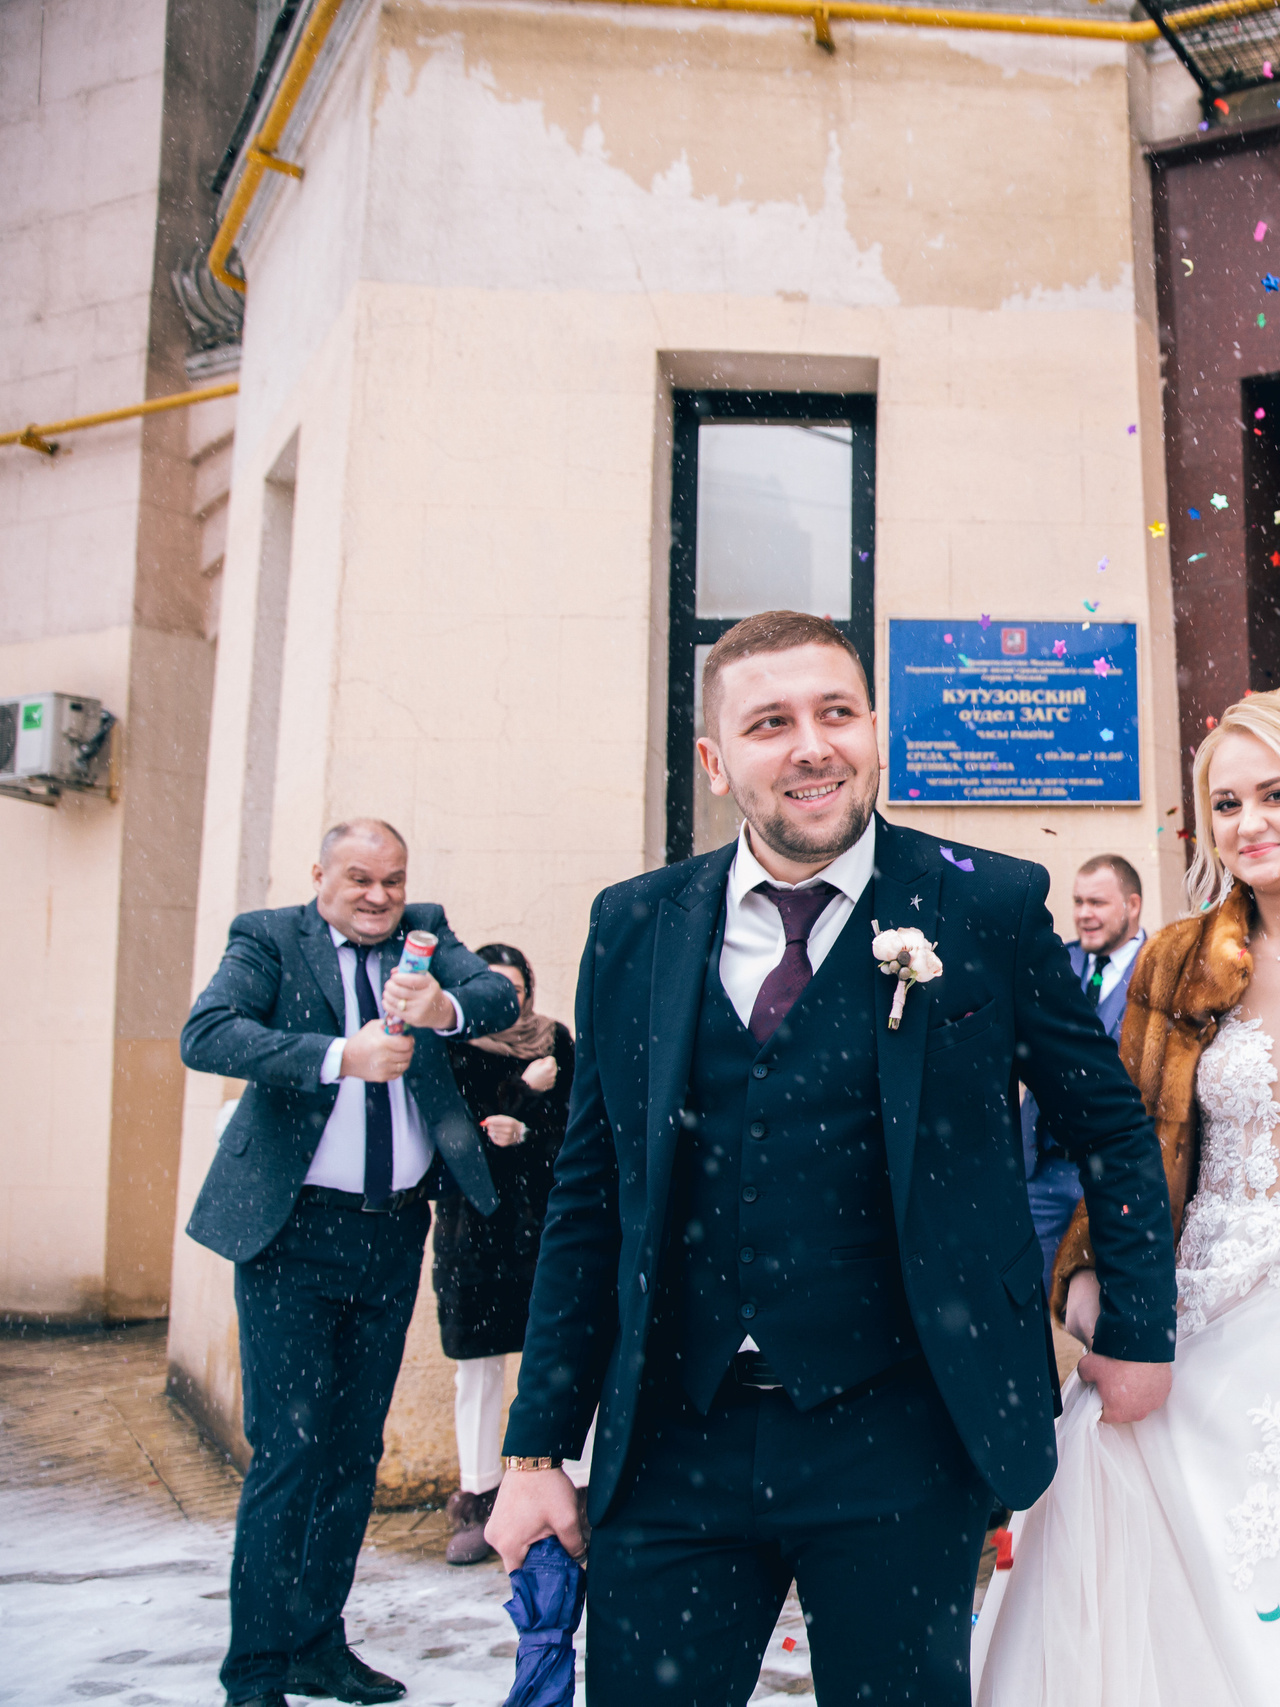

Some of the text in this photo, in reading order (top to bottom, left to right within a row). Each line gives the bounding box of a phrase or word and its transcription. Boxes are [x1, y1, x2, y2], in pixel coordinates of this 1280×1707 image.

[942, 687, 1086, 705] КУТУЗОВСКИЙ
[958, 706, 1071, 724] отдел ЗАГС
[976, 730, 1009, 740] ЧАСЫ
